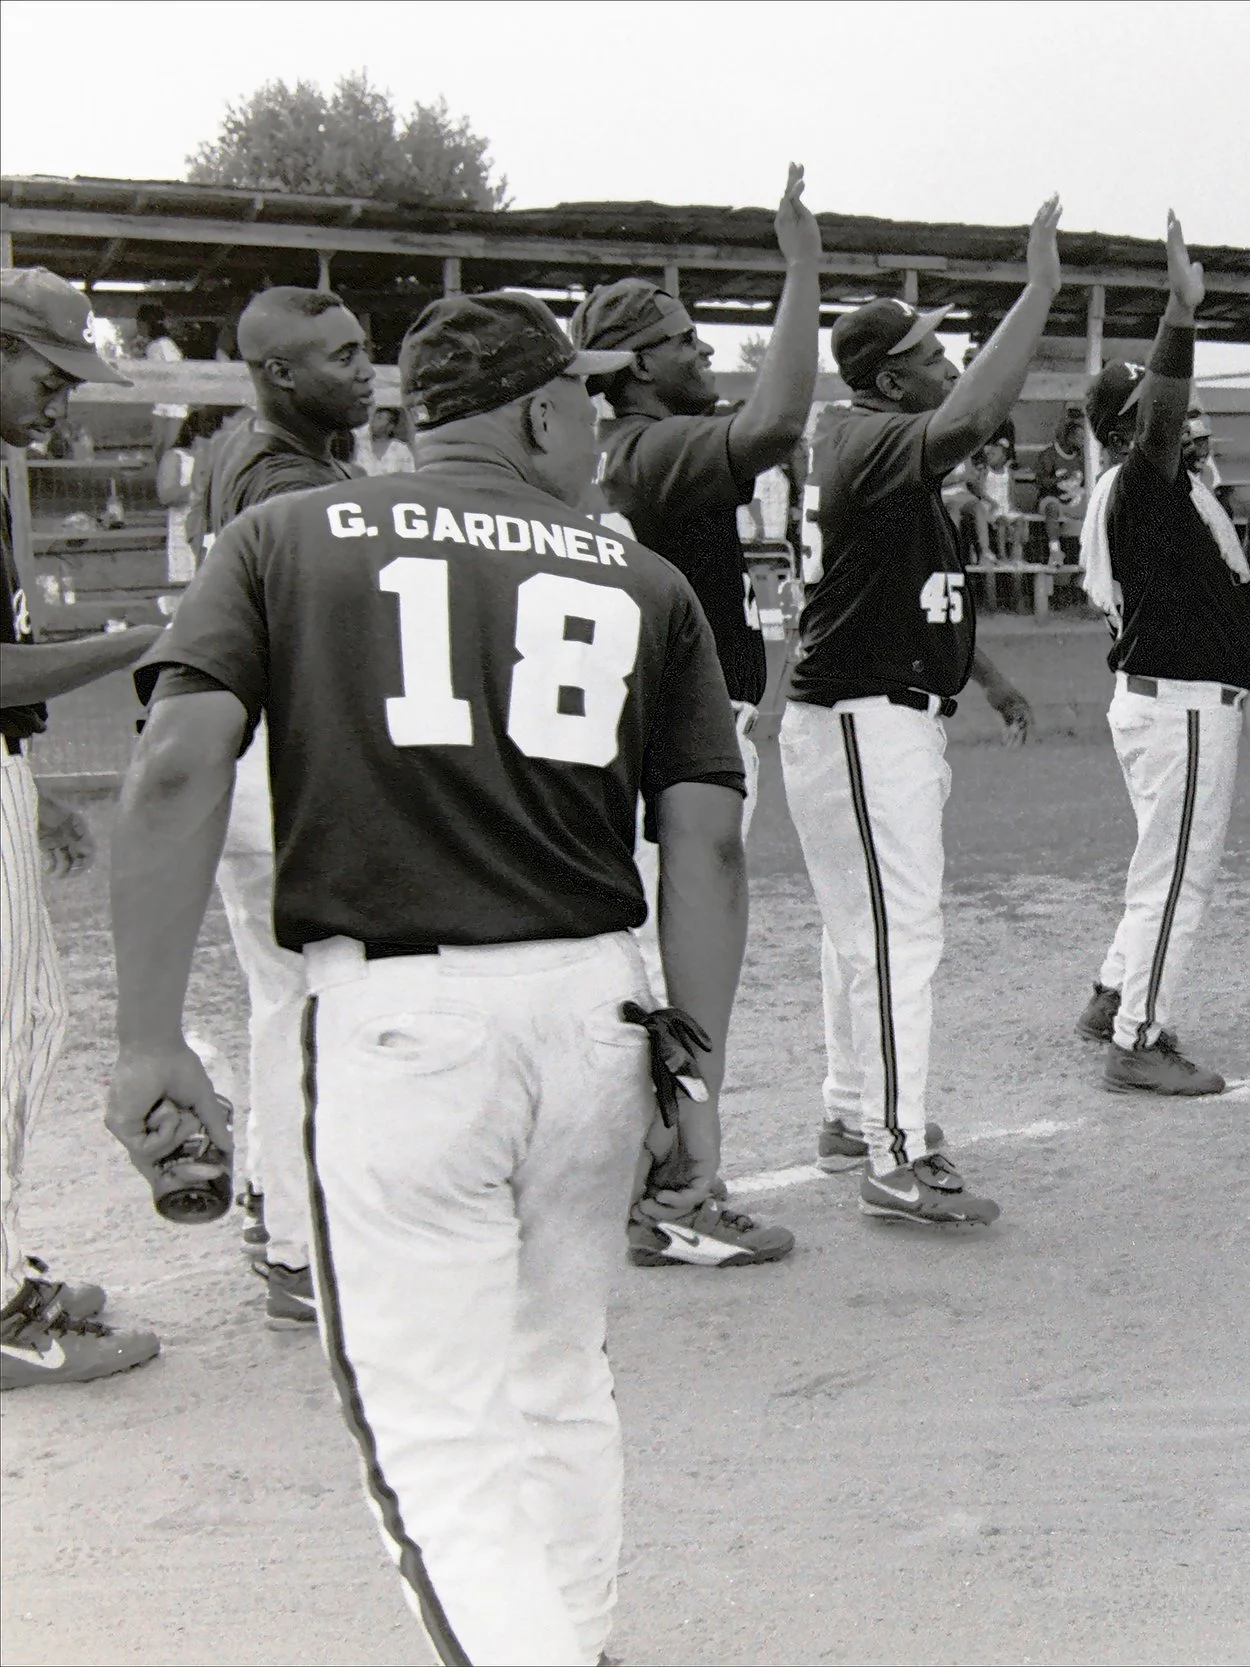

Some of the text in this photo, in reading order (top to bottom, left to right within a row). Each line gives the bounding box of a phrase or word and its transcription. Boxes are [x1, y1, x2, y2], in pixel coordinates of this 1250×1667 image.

[327, 503, 628, 567] G. GARDNER
[920, 572, 965, 623] 45
[379, 557, 642, 768] 18
